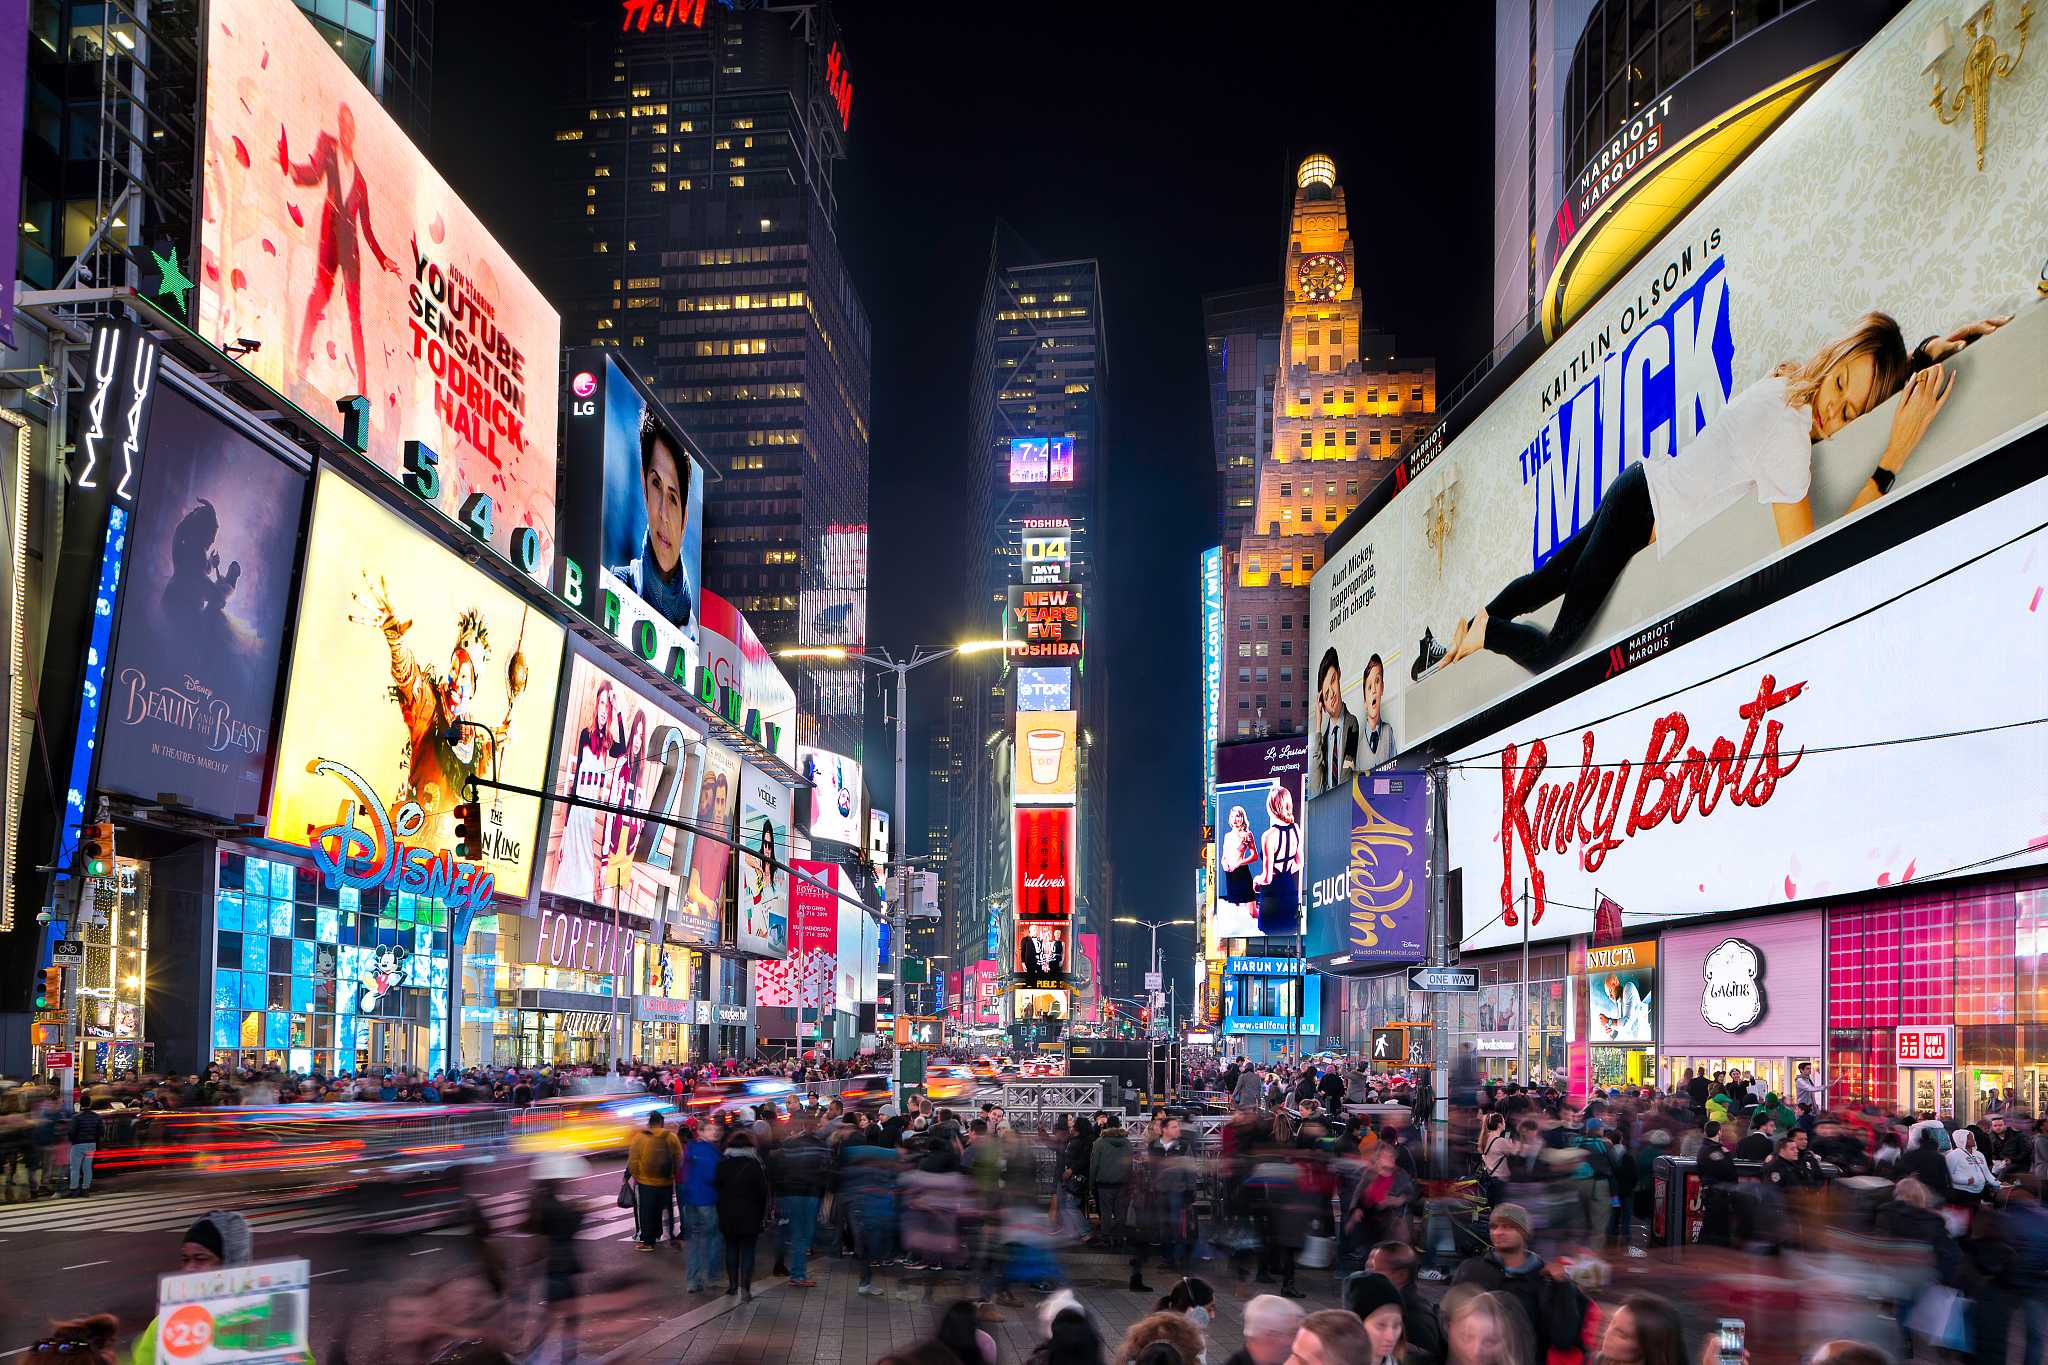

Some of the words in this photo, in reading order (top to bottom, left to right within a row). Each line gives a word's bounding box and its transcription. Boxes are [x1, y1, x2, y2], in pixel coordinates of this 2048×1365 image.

[1580, 95, 1674, 193] MARRIOTT
[1580, 129, 1661, 217] MARQUIS
[449, 263, 465, 289] NOW
[411, 230, 526, 386] YOUTUBE
[1541, 323, 1613, 413] KAITLIN
[1620, 245, 1694, 336] OLSON
[1702, 227, 1722, 260] IS
[408, 284, 526, 418] SENSATION
[408, 316, 525, 455] TODRICK
[573, 402, 607, 417] LG
[1533, 256, 1734, 570] MICK
[434, 379, 503, 471] HALL
[1019, 441, 1062, 462] 7:41
[1410, 421, 1447, 465] MARRIOTT
[1519, 424, 1551, 485] THE
[1410, 441, 1442, 479] MARQUIS
[1023, 519, 1070, 529] TOSHIBA
[1025, 538, 1067, 562] 04
[336, 394, 542, 576] 1540
[561, 555, 782, 756] BROADWAY
[1032, 565, 1061, 575] DAYS
[1331, 563, 1347, 591] Aunt
[1023, 591, 1069, 607] NEW
[1329, 610, 1342, 633] and
[1342, 605, 1349, 622] in
[1350, 585, 1377, 615] charge.
[1013, 607, 1078, 622] YEAR'S
[1027, 623, 1062, 639] EVE
[1628, 619, 1675, 651] MARRIOTT
[1009, 643, 1080, 656] TOSHIBA
[1628, 636, 1670, 663] MARQUIS
[1031, 683, 1069, 696] TDK
[151, 743, 161, 754] IN
[161, 745, 196, 764] THEATRES
[1500, 730, 1630, 927] Kinky
[1625, 673, 1809, 837] Boots
[490, 807, 503, 824] THE
[493, 829, 521, 864] KING
[1350, 768, 1414, 948] Aladdin
[535, 909, 635, 977] FOREVER
[1353, 949, 1421, 957] AladdinTheMusical.com
[1233, 960, 1272, 972] HARUN
[1429, 974, 1449, 985] ONE
[1451, 974, 1472, 985] WAY
[562, 1011, 603, 1033] FOREVER
[1477, 1038, 1515, 1051] Brookstone
[1925, 1035, 1942, 1046] UNI
[1925, 1046, 1944, 1058] QLO
[165, 1321, 211, 1346] $29
